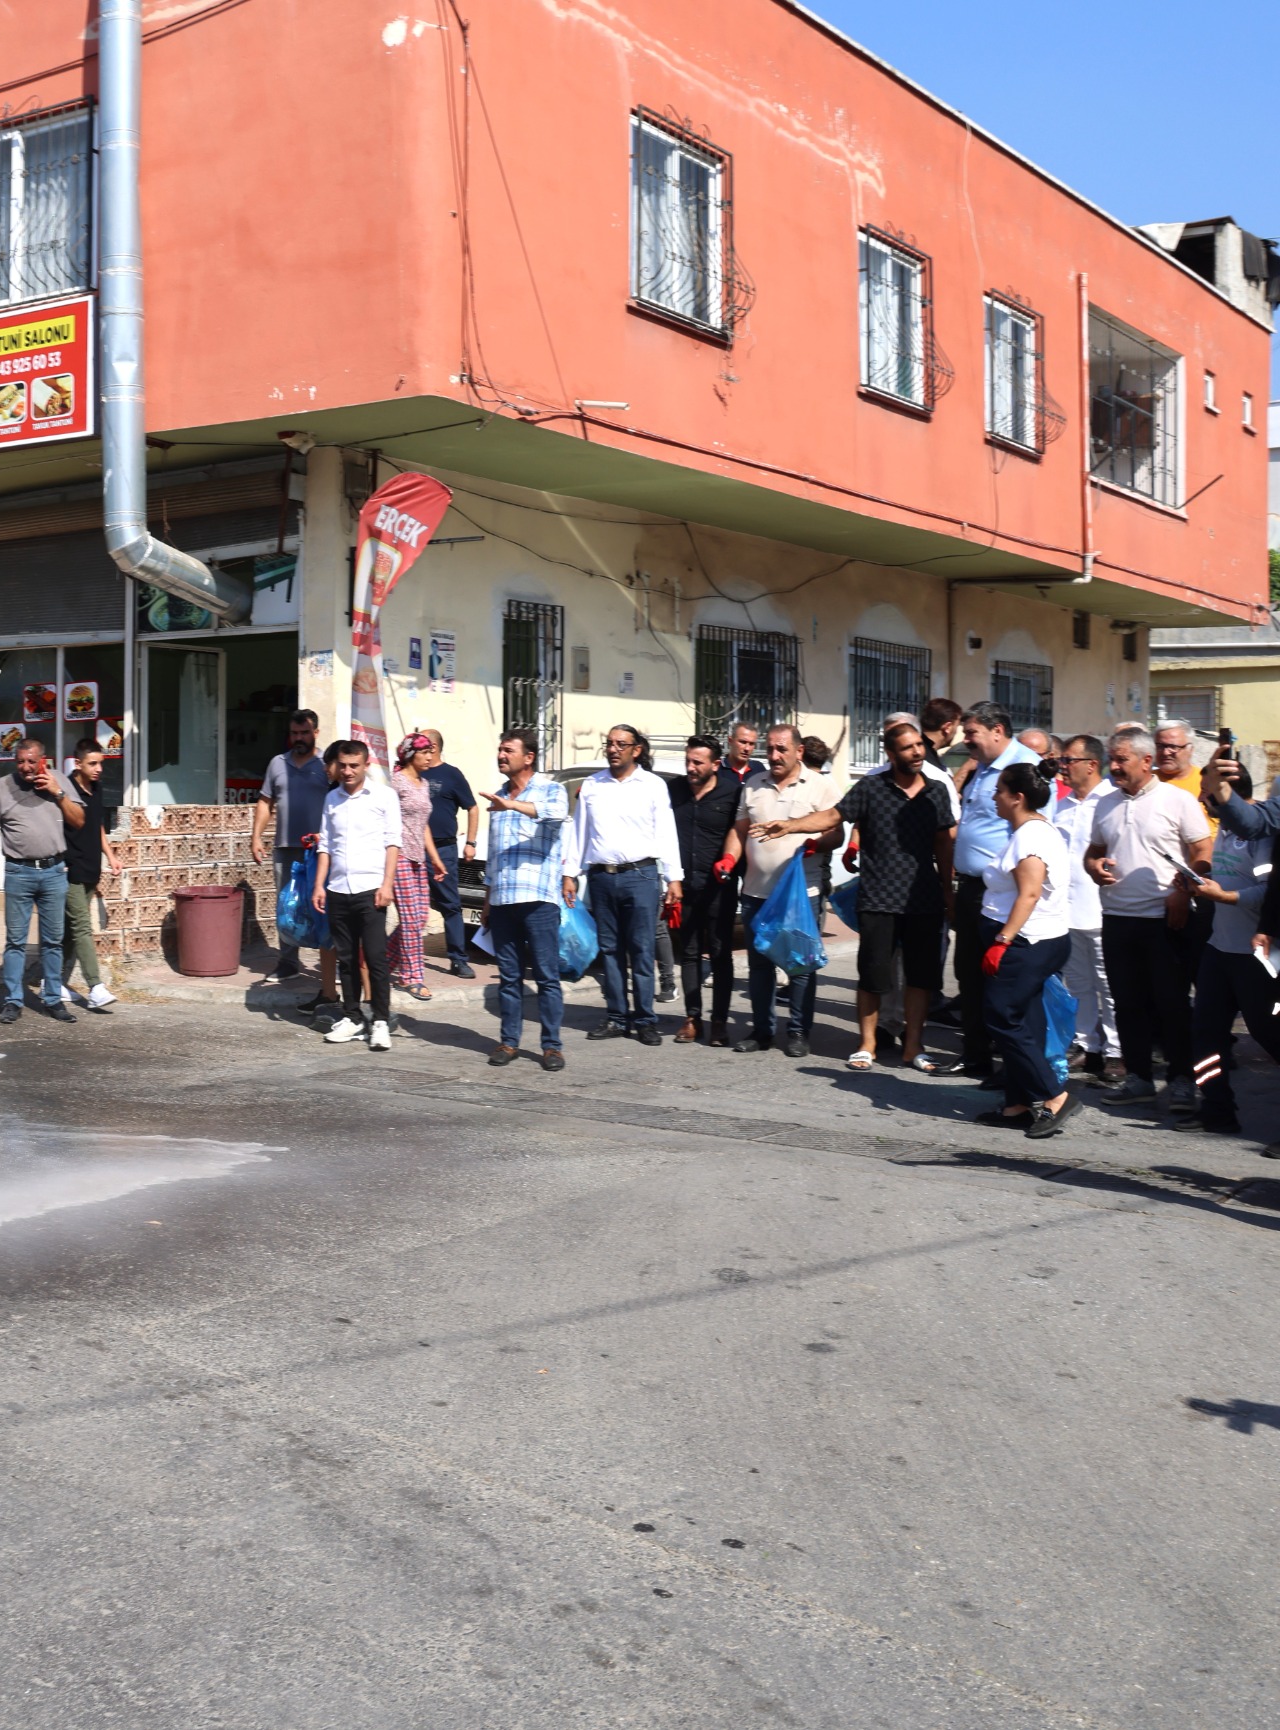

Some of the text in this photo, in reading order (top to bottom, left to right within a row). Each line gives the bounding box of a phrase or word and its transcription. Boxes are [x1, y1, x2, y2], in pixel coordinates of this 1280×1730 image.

[24, 324, 71, 347] SALONU
[12, 356, 32, 374] 925
[48, 351, 62, 367] 53
[373, 504, 429, 549] ERÇEK
